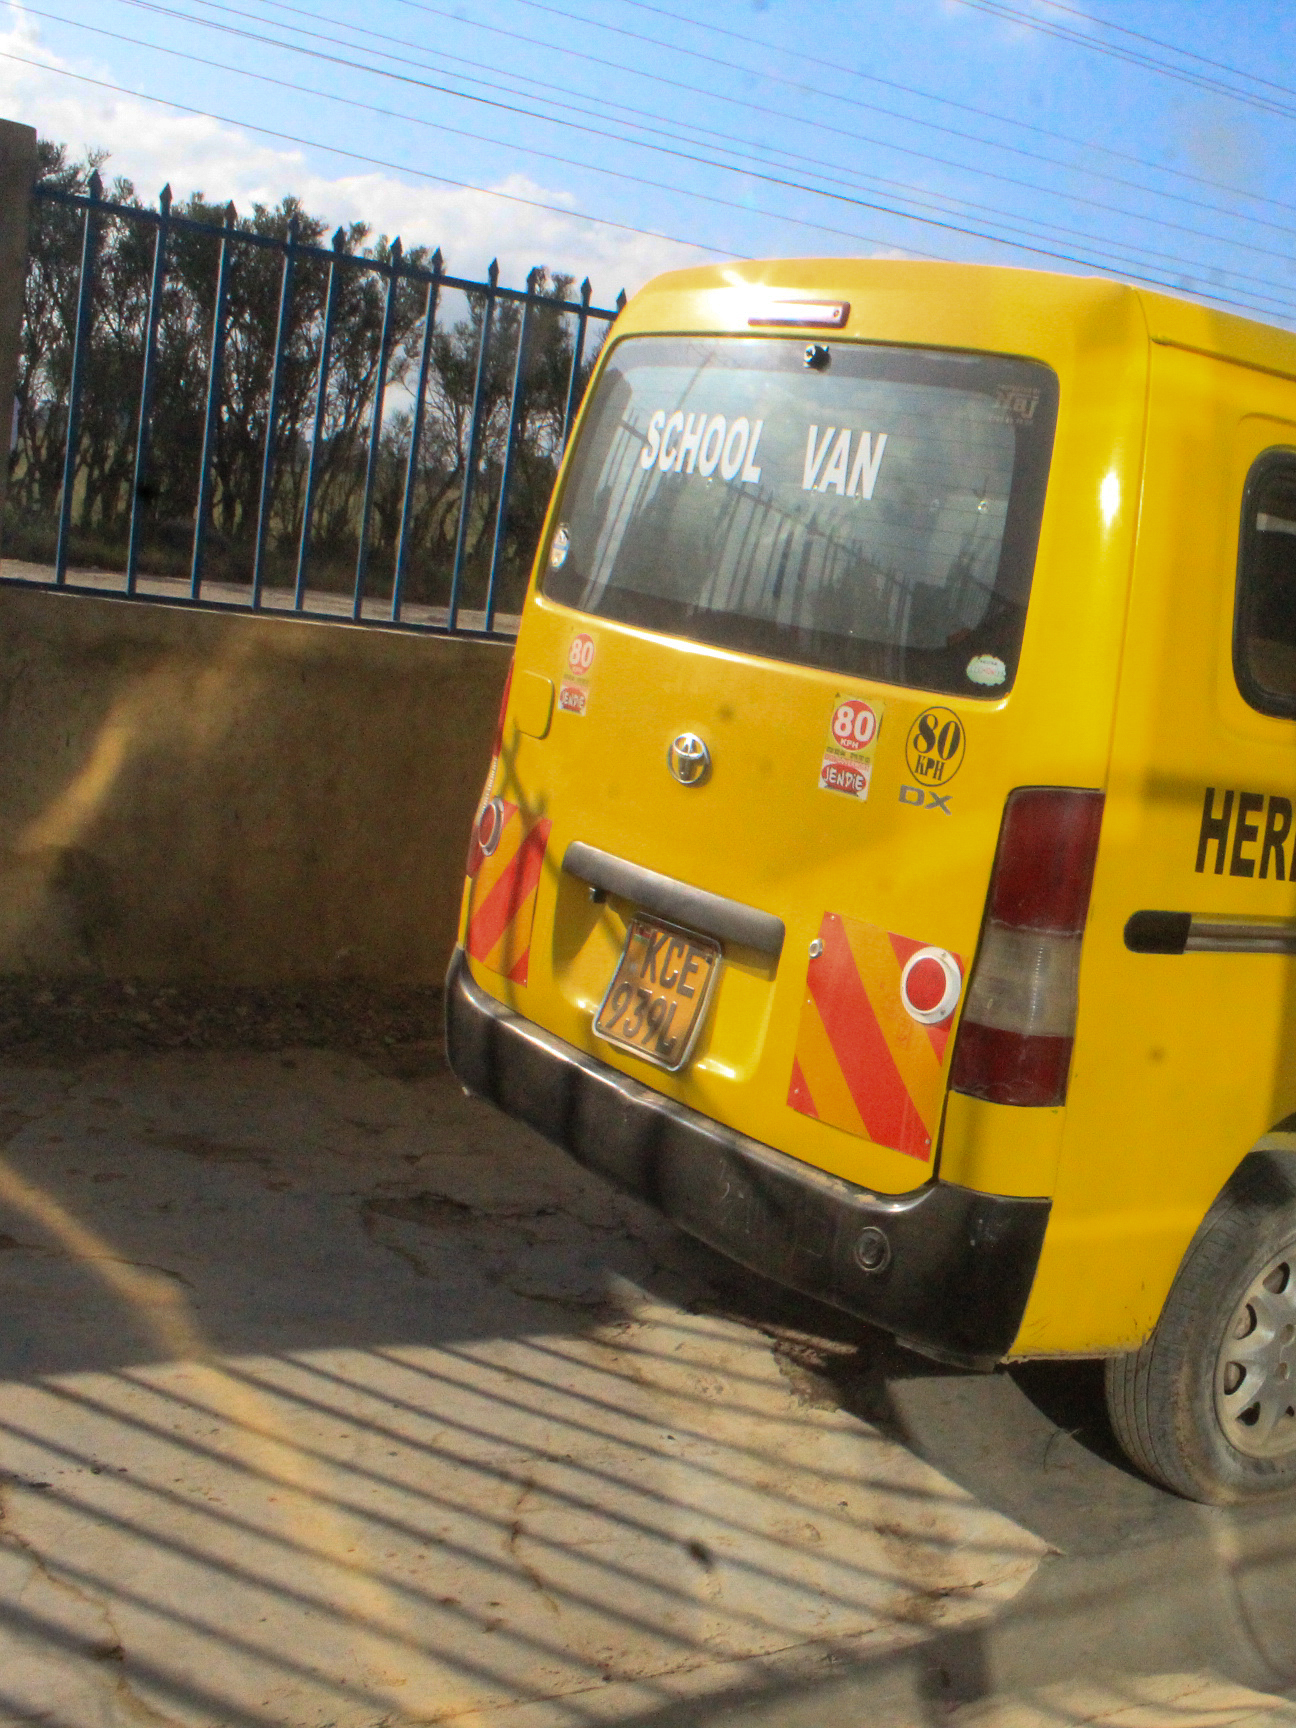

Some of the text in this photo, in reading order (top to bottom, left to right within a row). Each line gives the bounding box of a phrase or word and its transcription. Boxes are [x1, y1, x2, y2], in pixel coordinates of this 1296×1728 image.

[640, 409, 888, 500] SCHOOL VAN
[569, 638, 594, 668] 80
[833, 705, 875, 742] 80
[913, 713, 961, 761] 80
[839, 737, 859, 749] KPH
[914, 754, 946, 781] KPH
[898, 784, 953, 816] DX
[640, 930, 707, 999] KCE
[605, 981, 678, 1056] 939L
